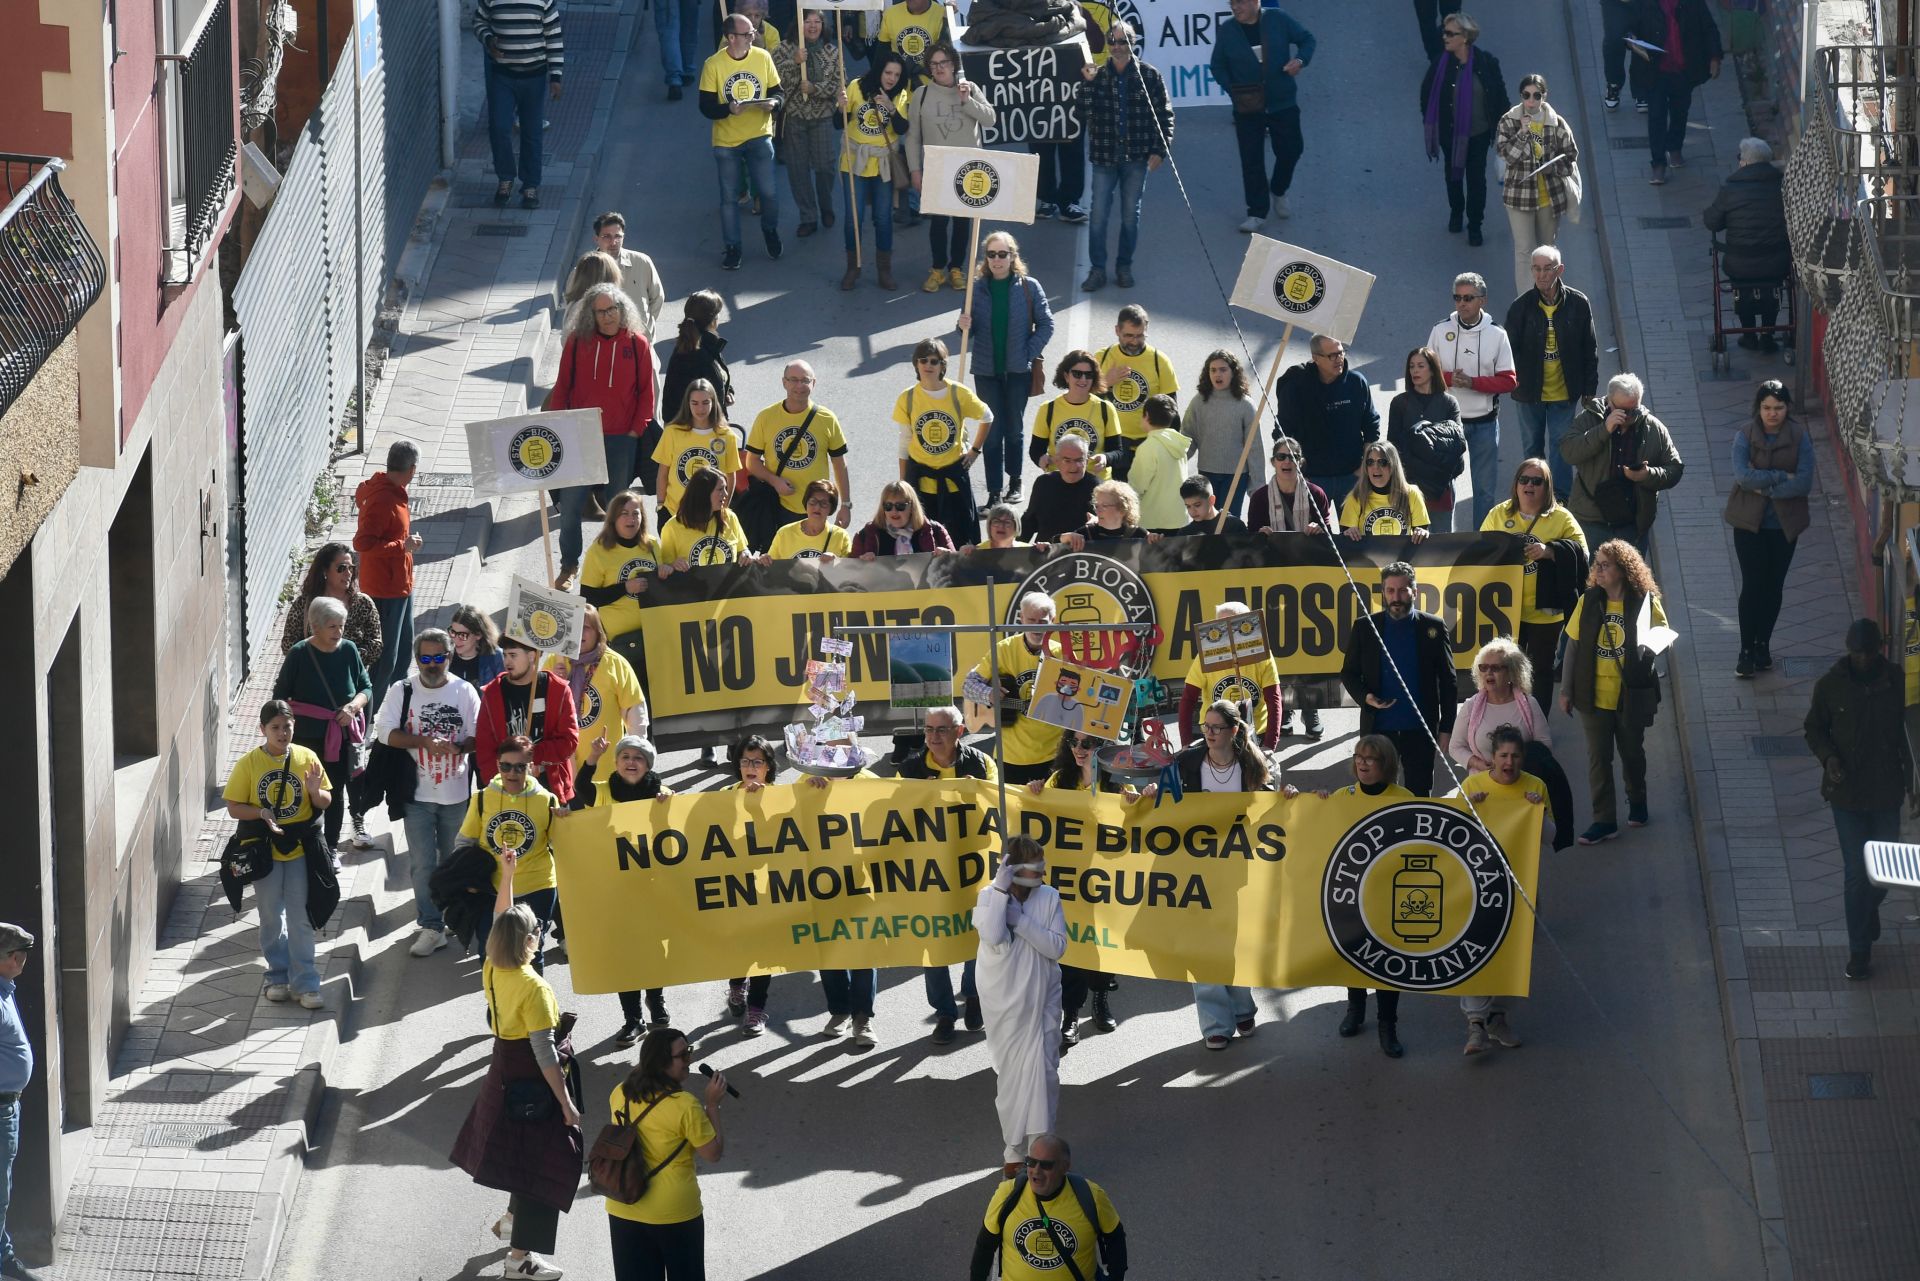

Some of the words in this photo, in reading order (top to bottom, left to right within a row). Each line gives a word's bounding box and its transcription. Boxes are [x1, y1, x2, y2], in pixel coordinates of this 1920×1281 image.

[989, 46, 1057, 80] ESTA
[982, 78, 1055, 107] LANTA
[1278, 294, 1313, 311] MOLINA
[521, 461, 558, 477] MOLINA
[788, 457, 812, 468] OLINA
[679, 615, 756, 695] NO
[775, 605, 958, 688] JUN
[616, 829, 689, 870] NO
[700, 824, 737, 861] A
[744, 817, 810, 856] LA
[817, 803, 1002, 850] PLANTA
[1020, 810, 1084, 850] DE
[1096, 815, 1287, 862] BIOGÁS
[695, 872, 758, 911] EN
[768, 858, 950, 904] MOLINA
[1048, 865, 1212, 910] EGURA
[791, 912, 976, 945] PLATAFORM
[1353, 938, 1487, 981] MOLINA
